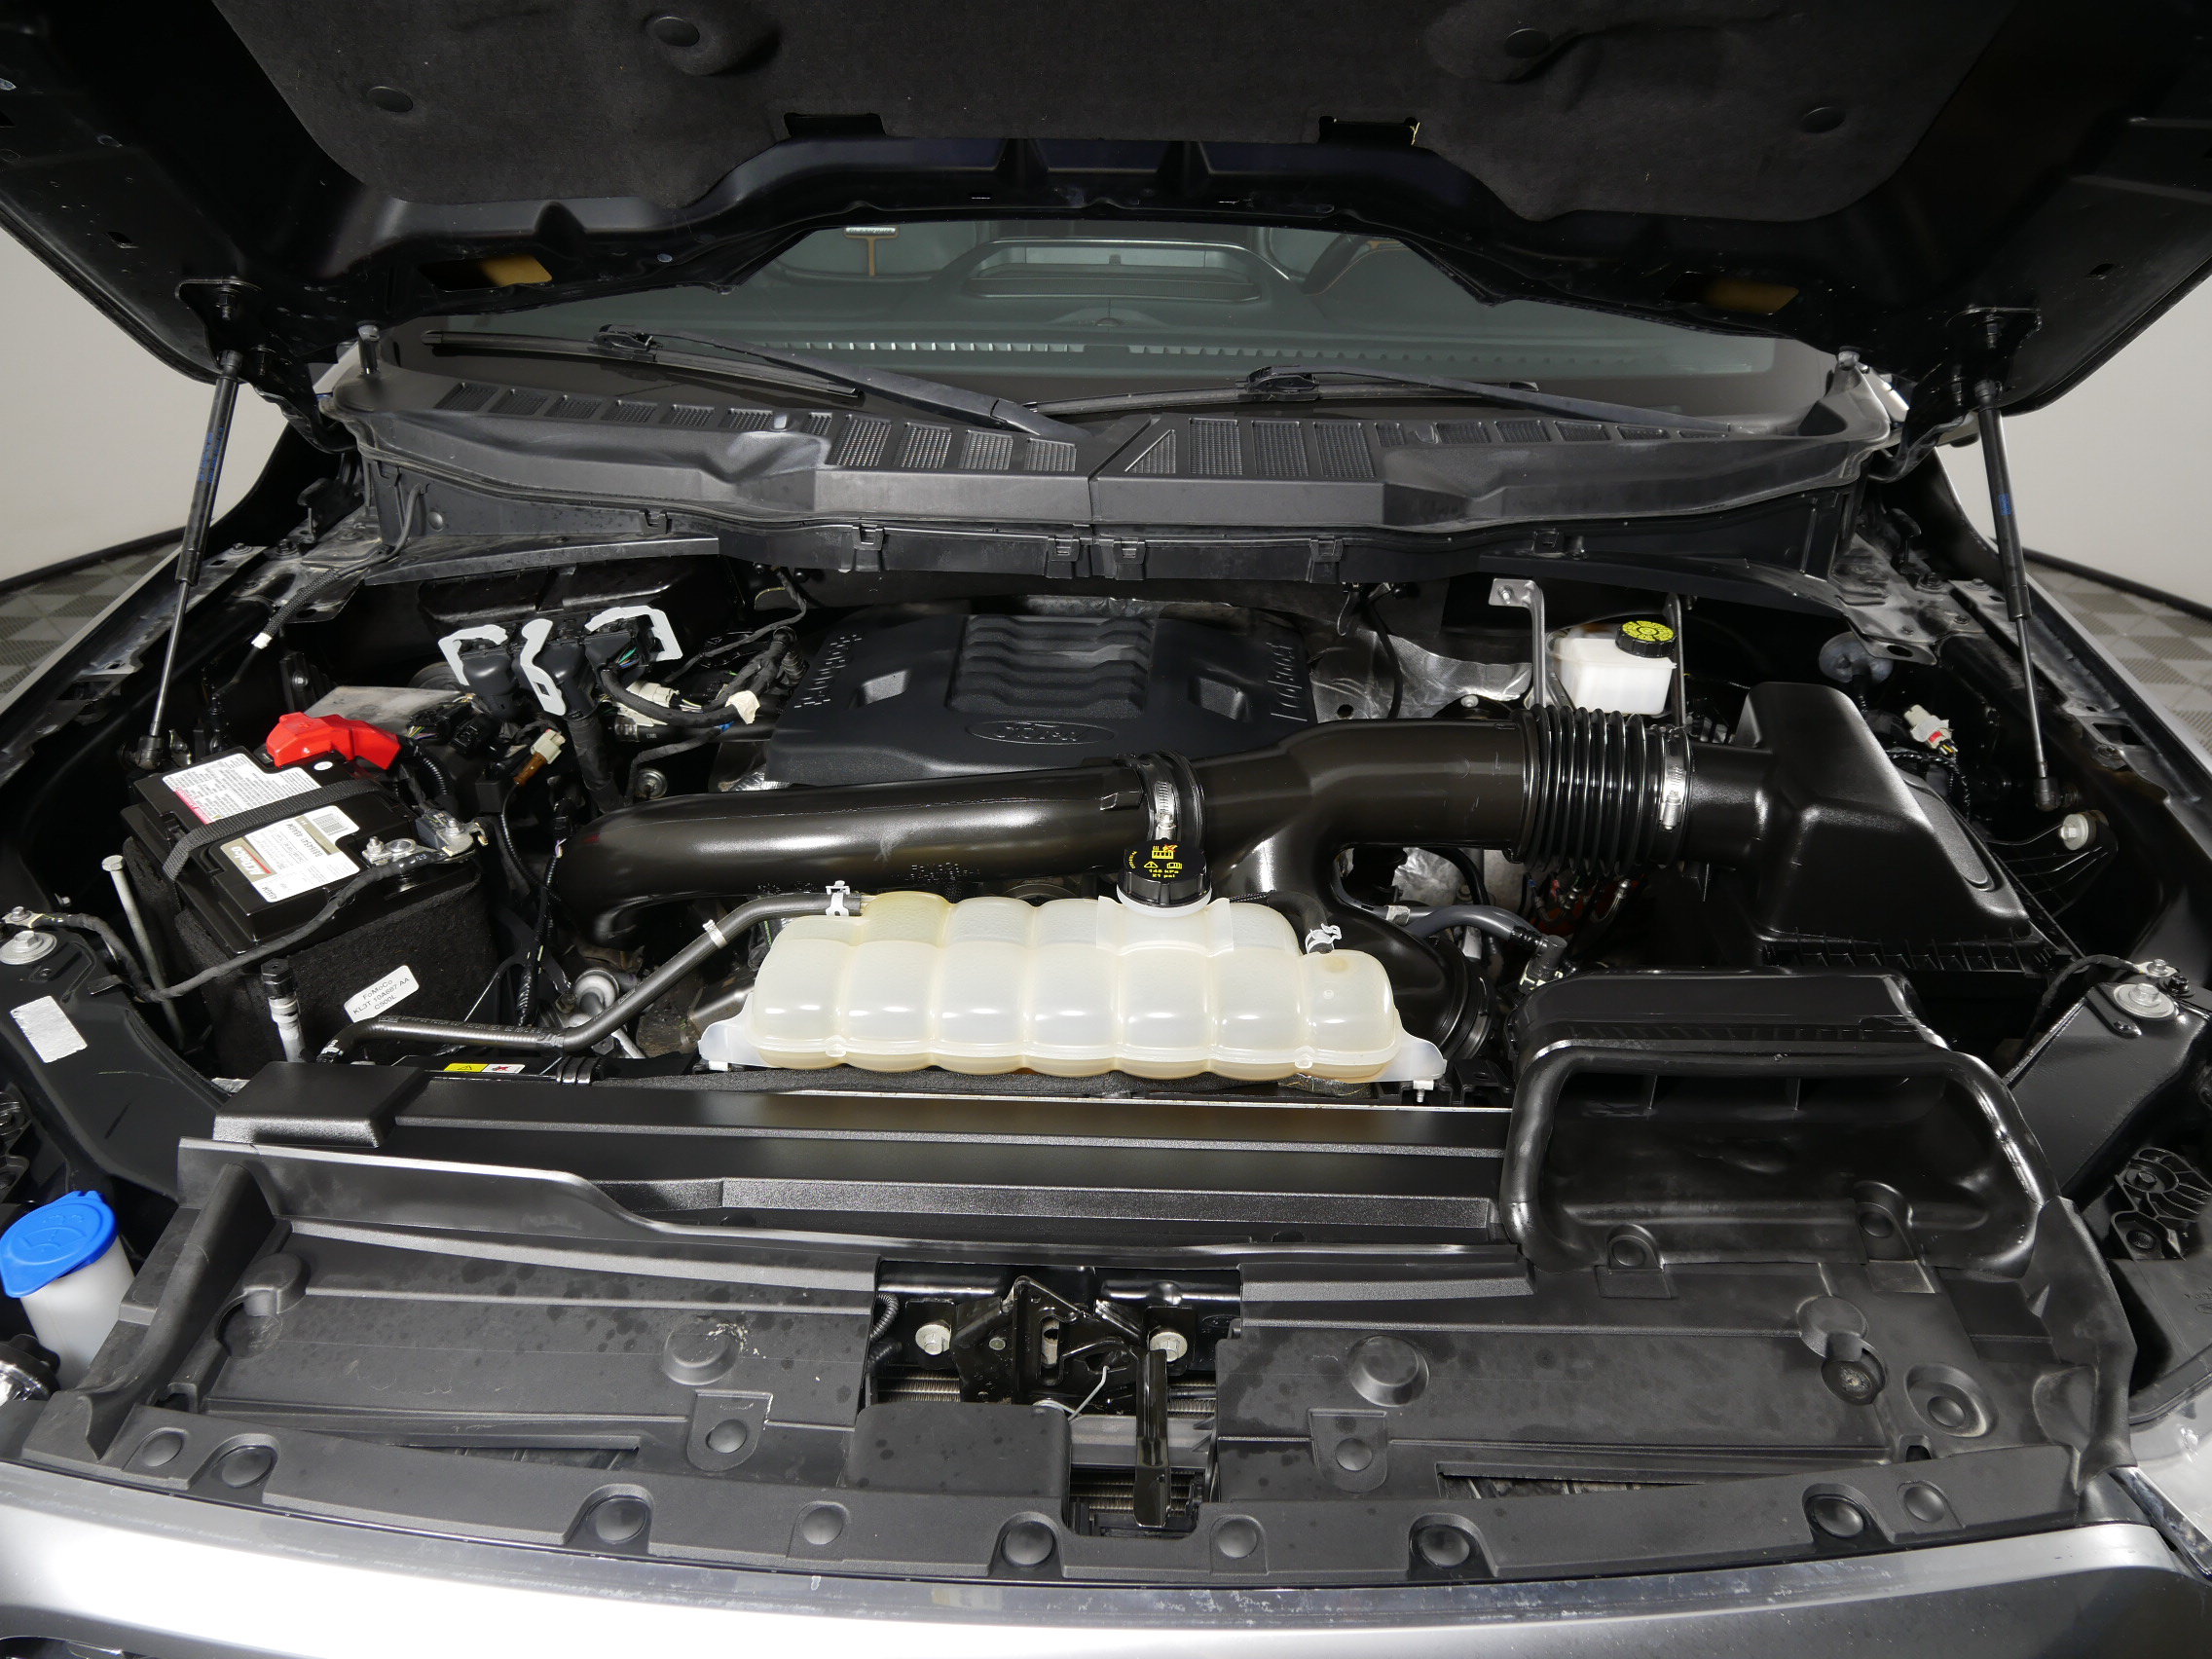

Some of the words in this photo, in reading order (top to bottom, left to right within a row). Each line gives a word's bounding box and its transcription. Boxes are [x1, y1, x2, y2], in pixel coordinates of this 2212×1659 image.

[230, 846, 265, 876] ACDelco
[352, 1001, 372, 1015] KL3T
[399, 977, 410, 987] AA
[362, 979, 393, 1001] FoMoCo
